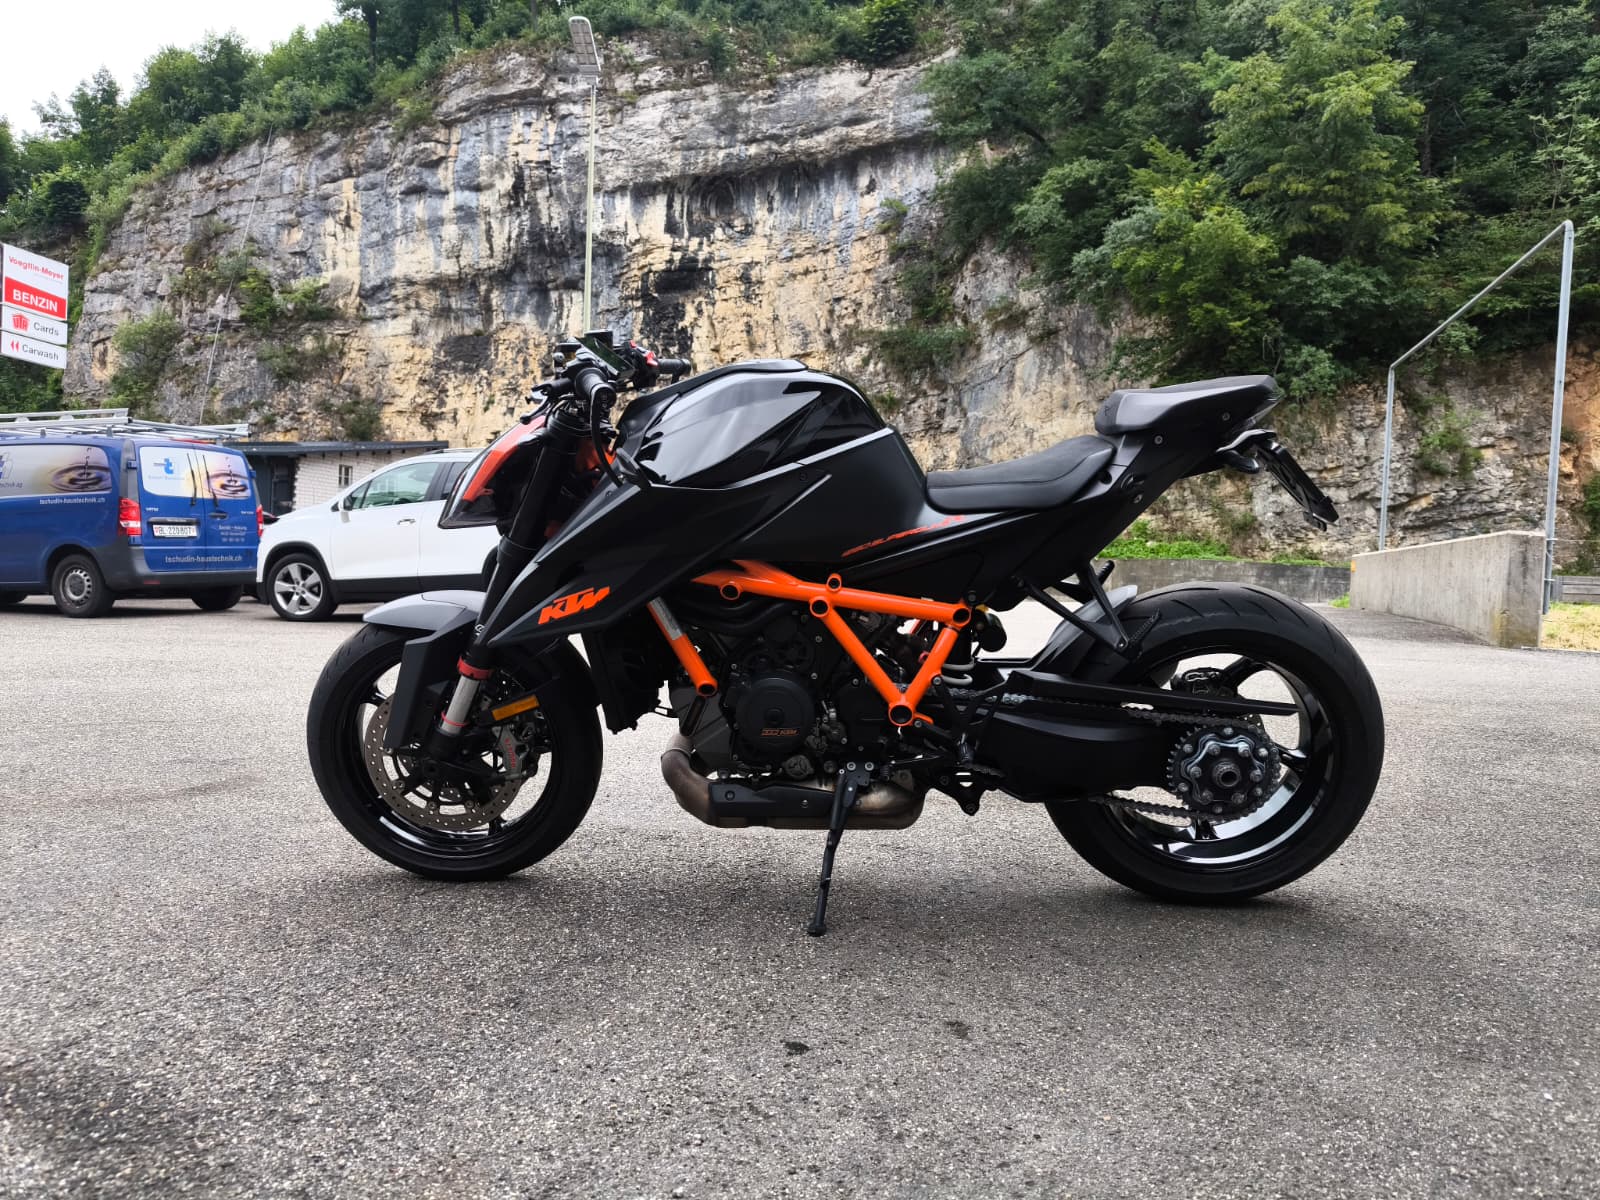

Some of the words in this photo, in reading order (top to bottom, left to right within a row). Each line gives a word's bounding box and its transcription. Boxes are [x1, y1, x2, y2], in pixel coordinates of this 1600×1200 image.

[13, 289, 58, 312] BENZIN
[34, 322, 59, 336] Cards
[22, 344, 59, 360] Carwash
[538, 586, 610, 624] KTM
